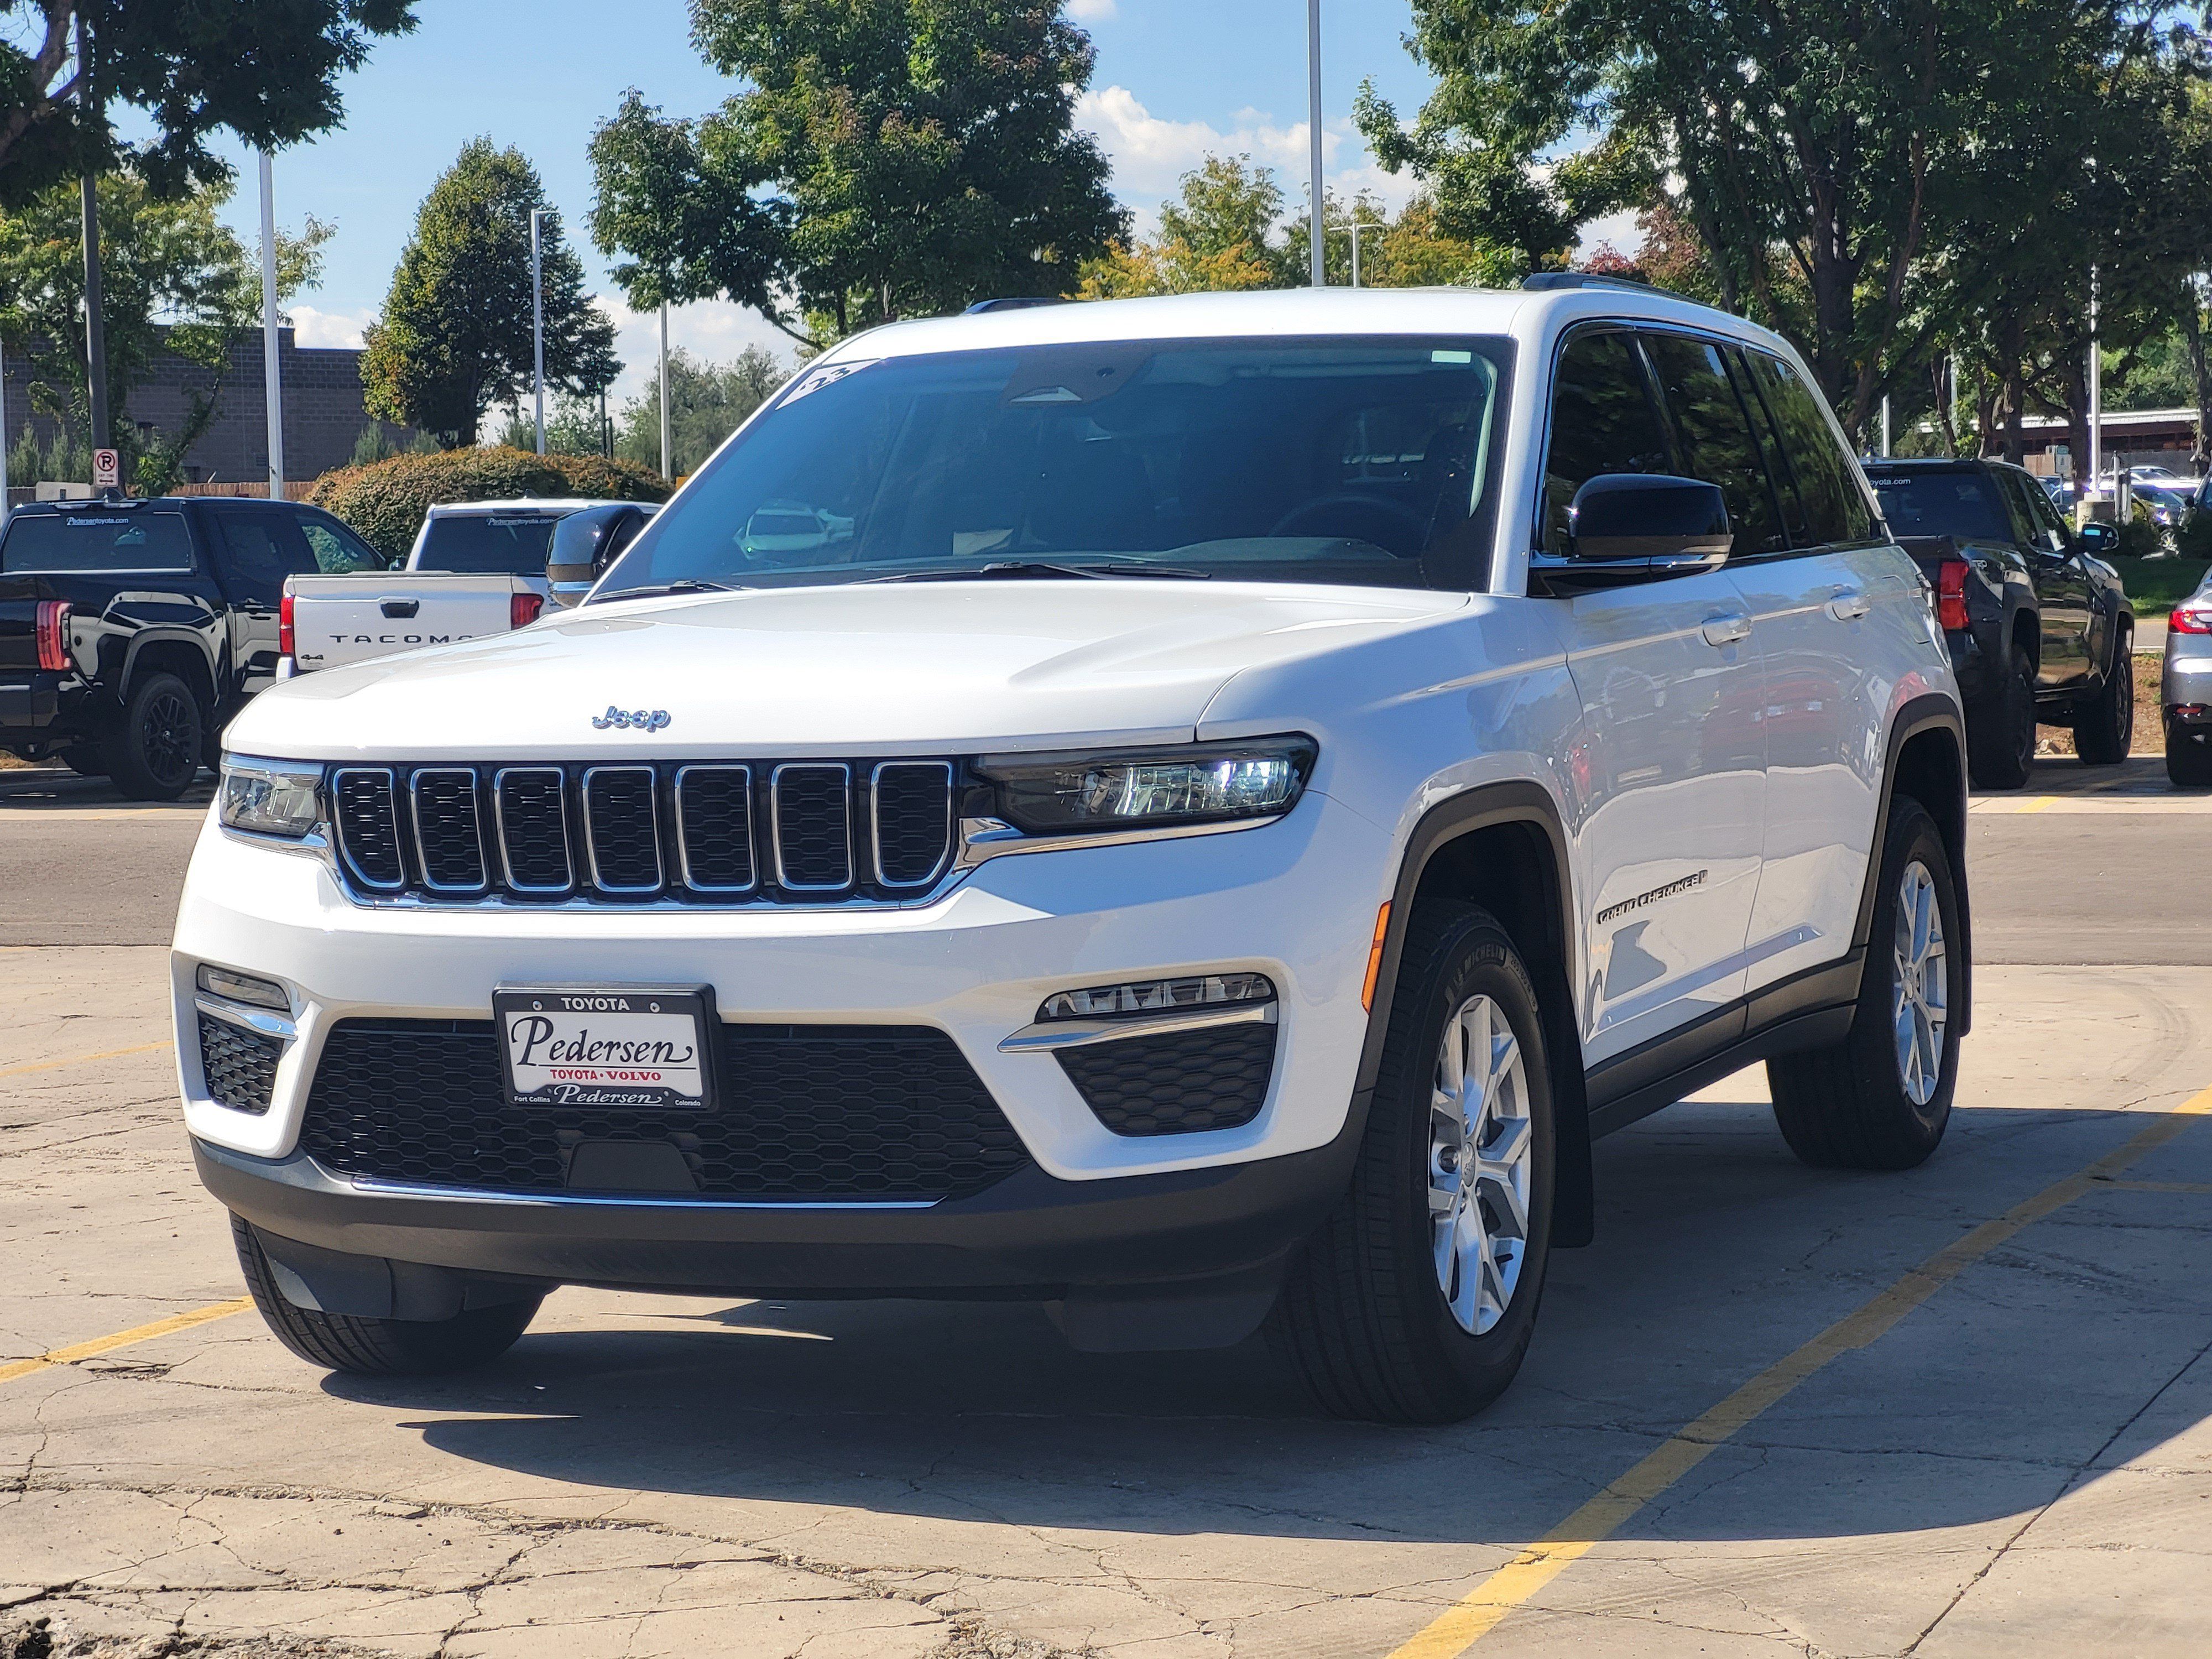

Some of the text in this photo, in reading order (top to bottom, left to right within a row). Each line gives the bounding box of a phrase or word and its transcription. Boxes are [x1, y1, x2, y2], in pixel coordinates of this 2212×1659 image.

[592, 706, 671, 733] Jeep
[1597, 874, 1699, 925] GRAND CHEROKEE
[1464, 943, 1506, 975] MICHELIN
[561, 998, 630, 1011] TOYOTA
[511, 1016, 693, 1066] Pedersen
[550, 1069, 662, 1081] TOYOTA VOLVO
[554, 1084, 662, 1104] Pedersen
